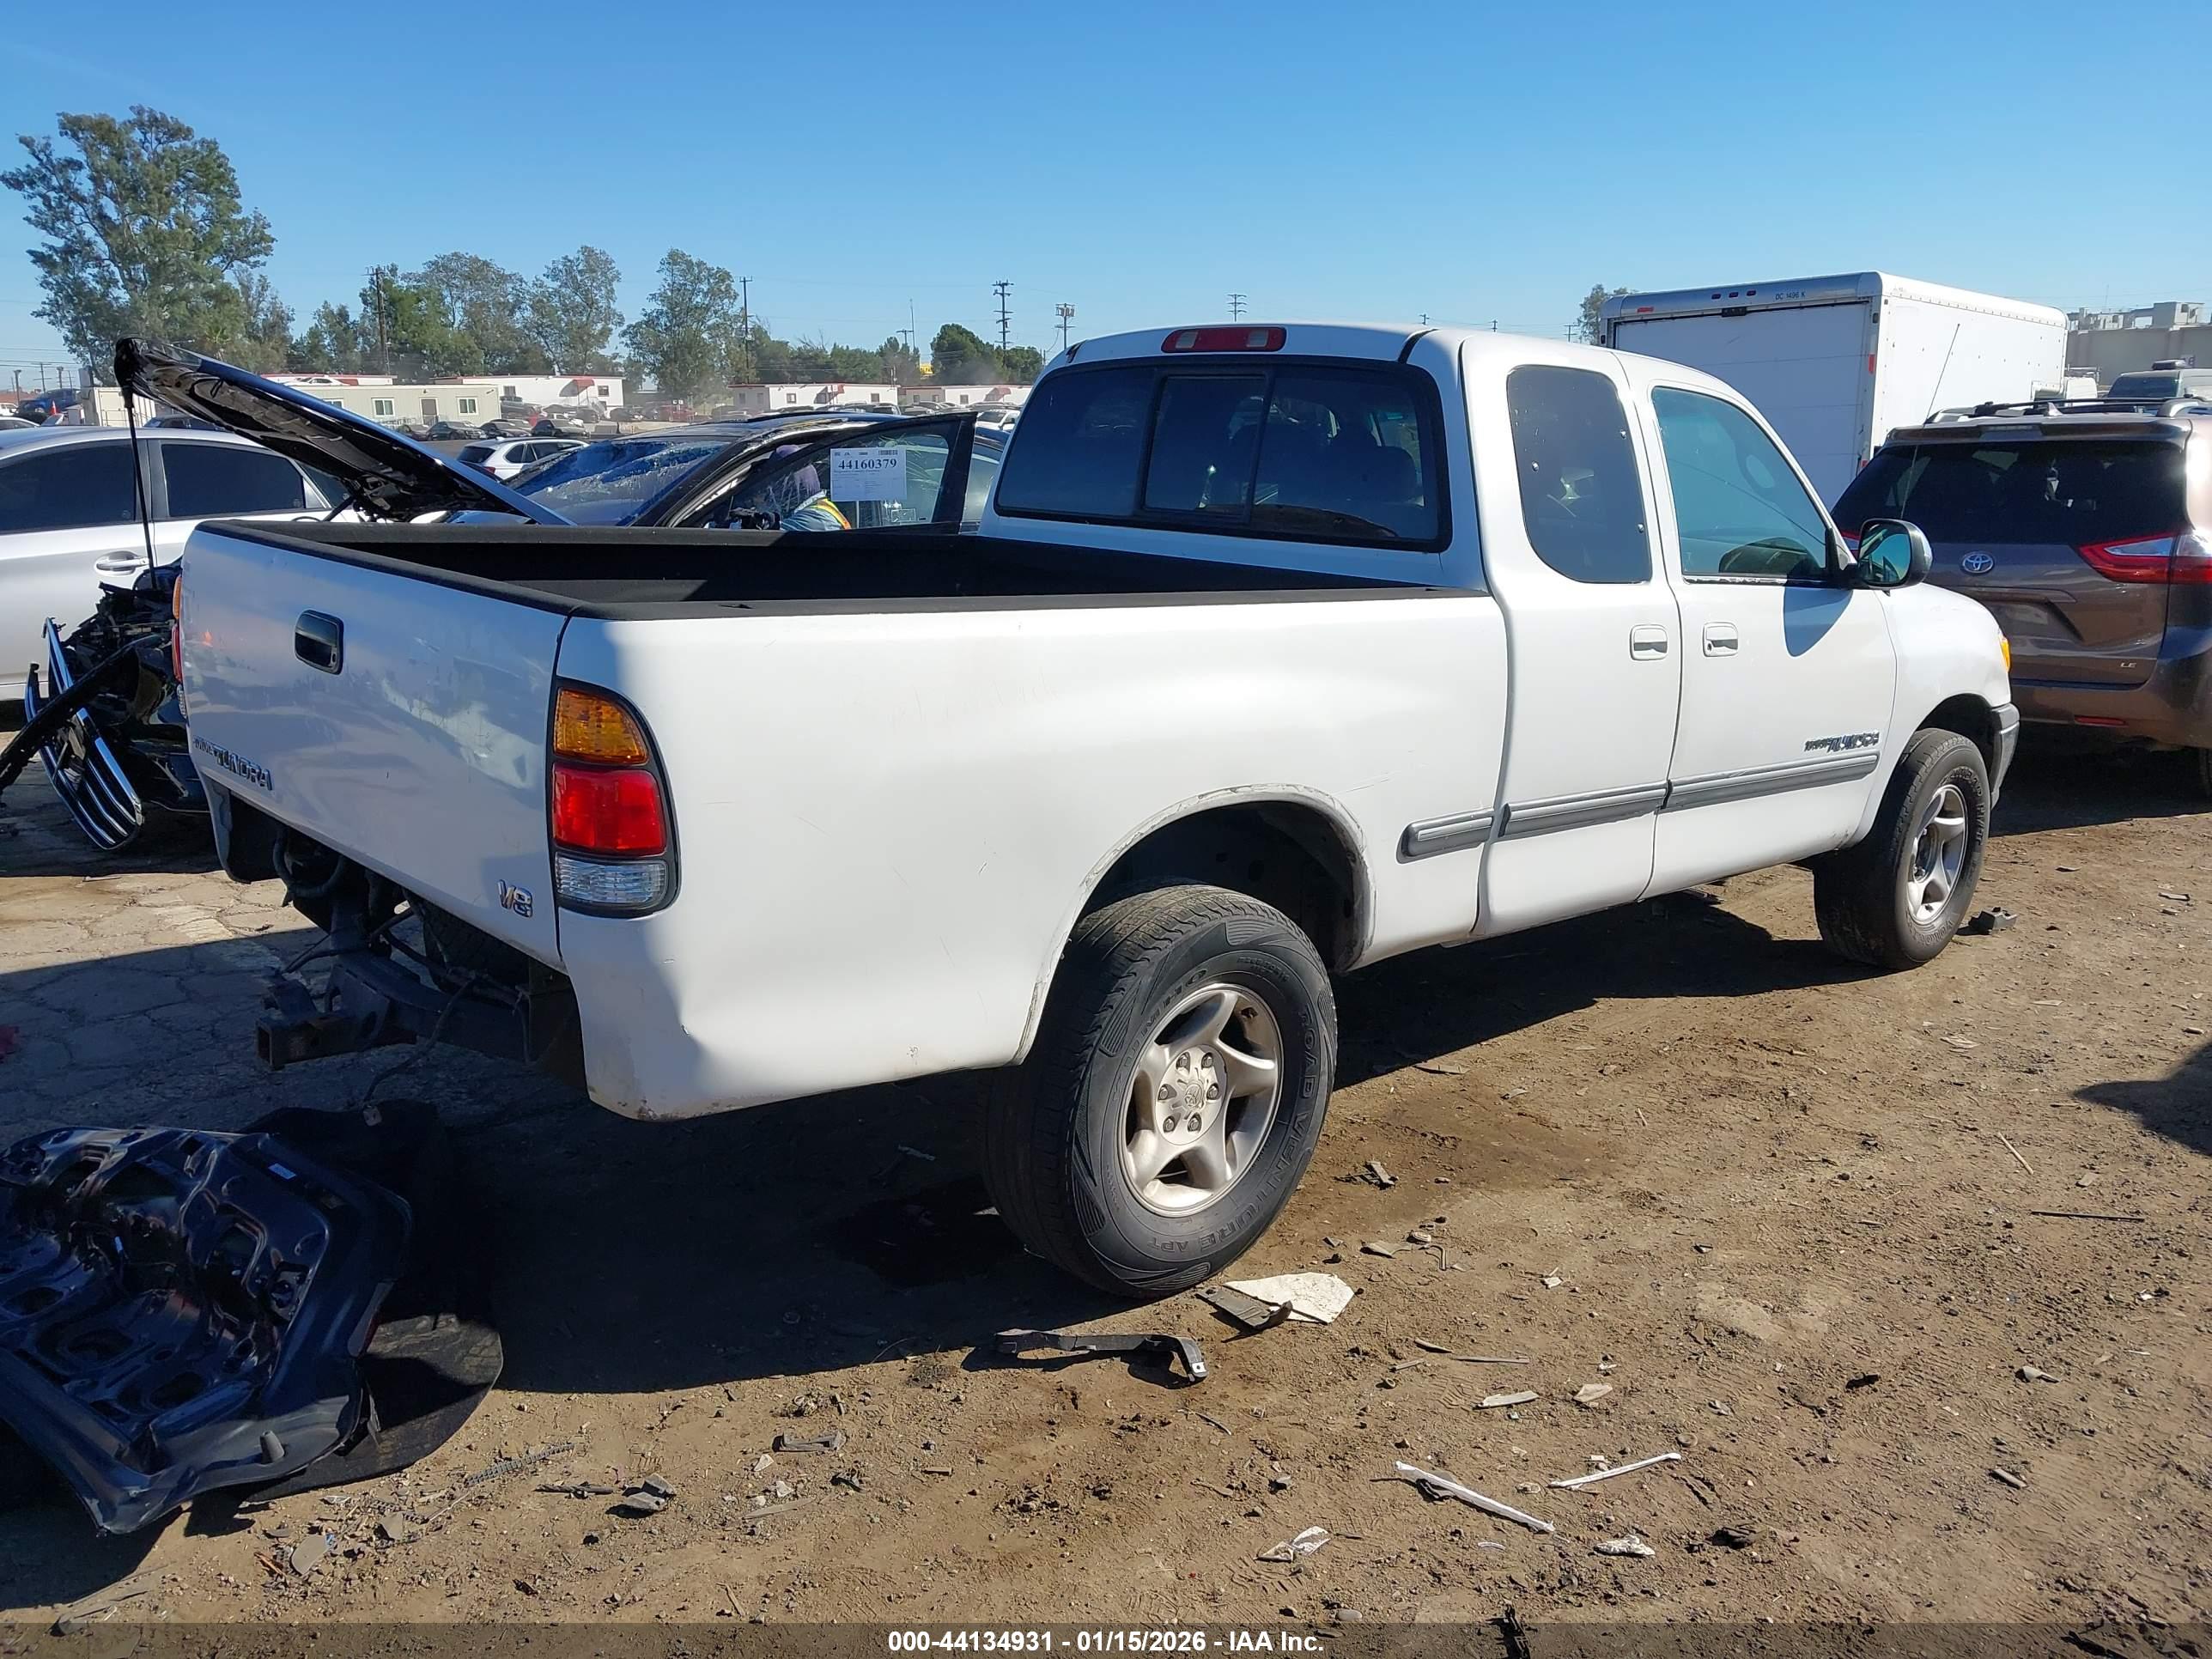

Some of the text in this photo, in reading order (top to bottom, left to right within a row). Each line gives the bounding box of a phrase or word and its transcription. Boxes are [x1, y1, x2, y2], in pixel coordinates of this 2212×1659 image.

[838, 458, 897, 470] 44160379
[211, 744, 273, 791] TUNDRA
[498, 879, 533, 918] V8
[1197, 1111, 1310, 1253] VENTURE
[1148, 1237, 1189, 1254] APT
